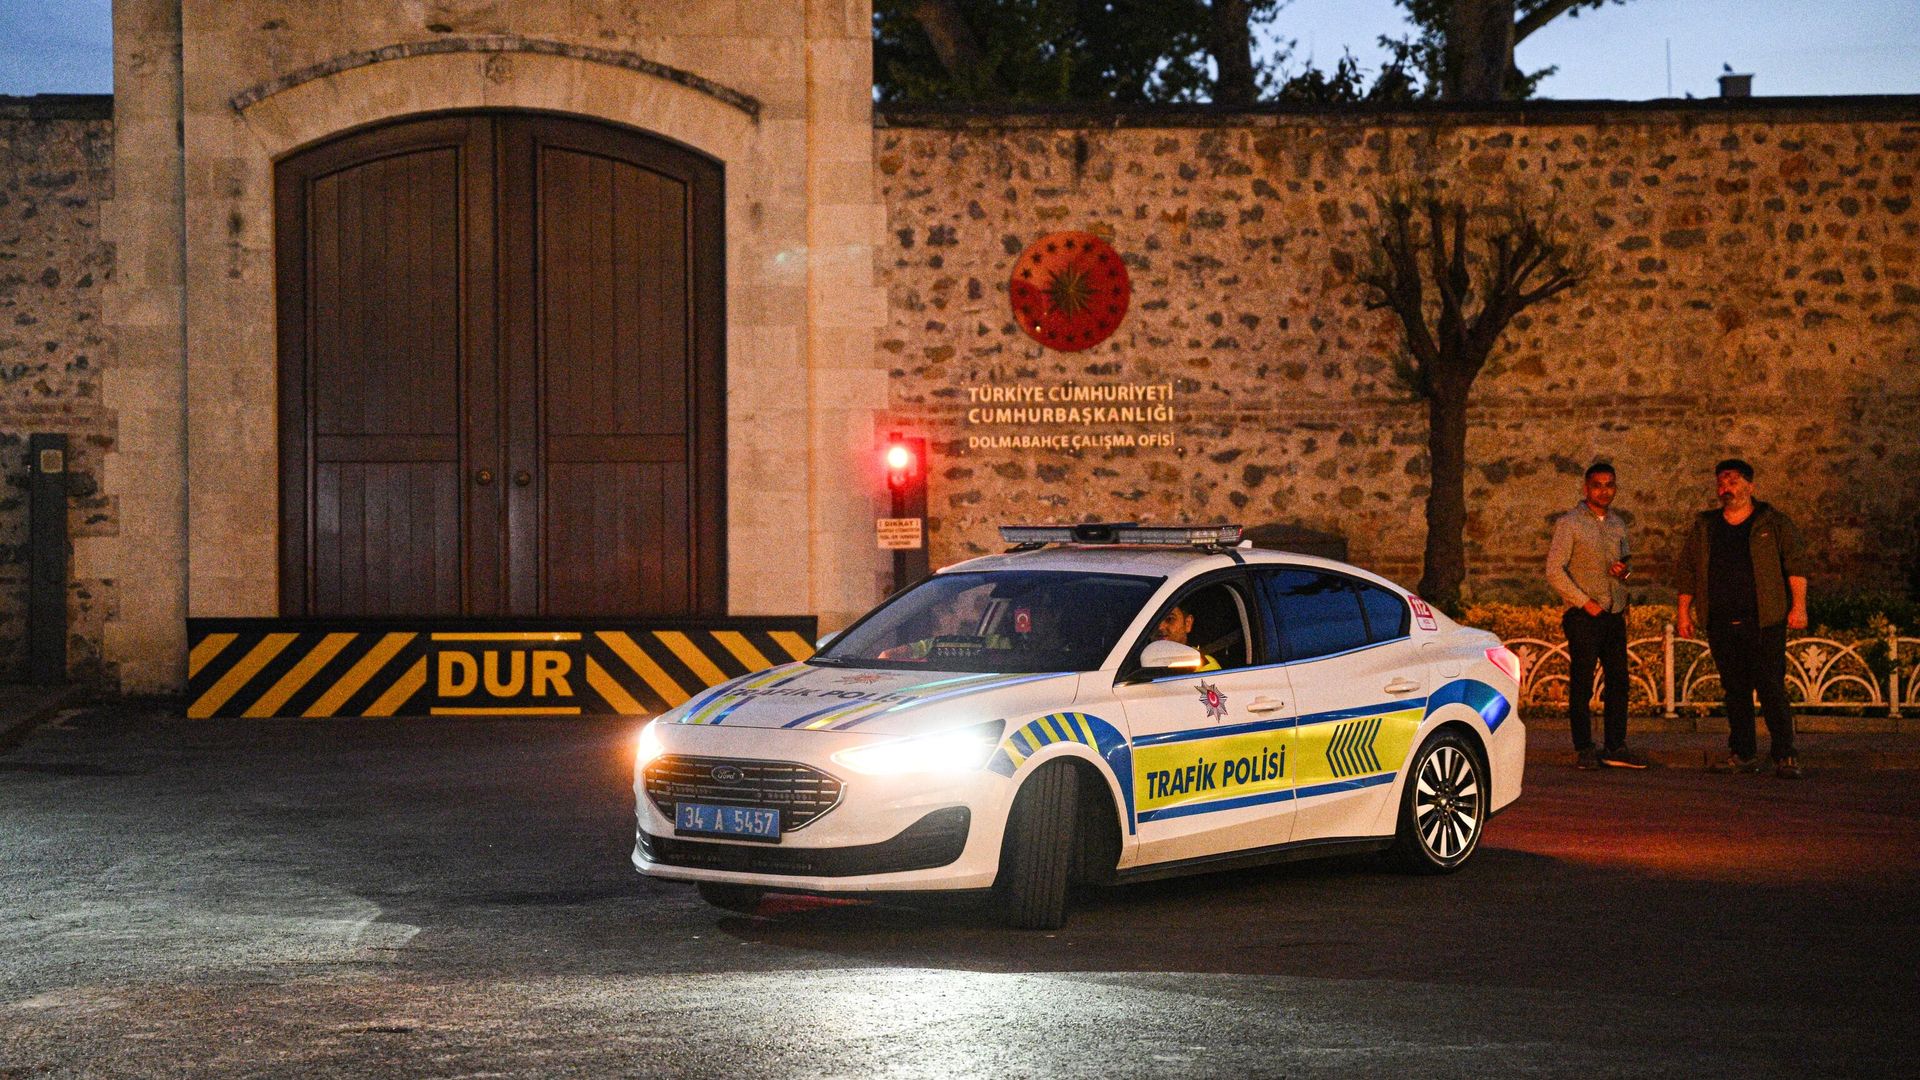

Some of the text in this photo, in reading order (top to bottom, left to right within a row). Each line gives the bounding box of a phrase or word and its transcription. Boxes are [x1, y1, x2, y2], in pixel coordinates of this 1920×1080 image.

[968, 382, 1174, 402] TÜRKİYE CUMHURİYETİ
[968, 403, 1174, 426] CUMHURBAŞKANLIĞI
[969, 432, 1175, 450] DOLMABAHÇE ÇALIŞMA OFİSİ
[437, 650, 575, 698] DUR
[1146, 744, 1286, 800] TRAFİK POLİSİ
[685, 806, 774, 835] 34 A 5457
